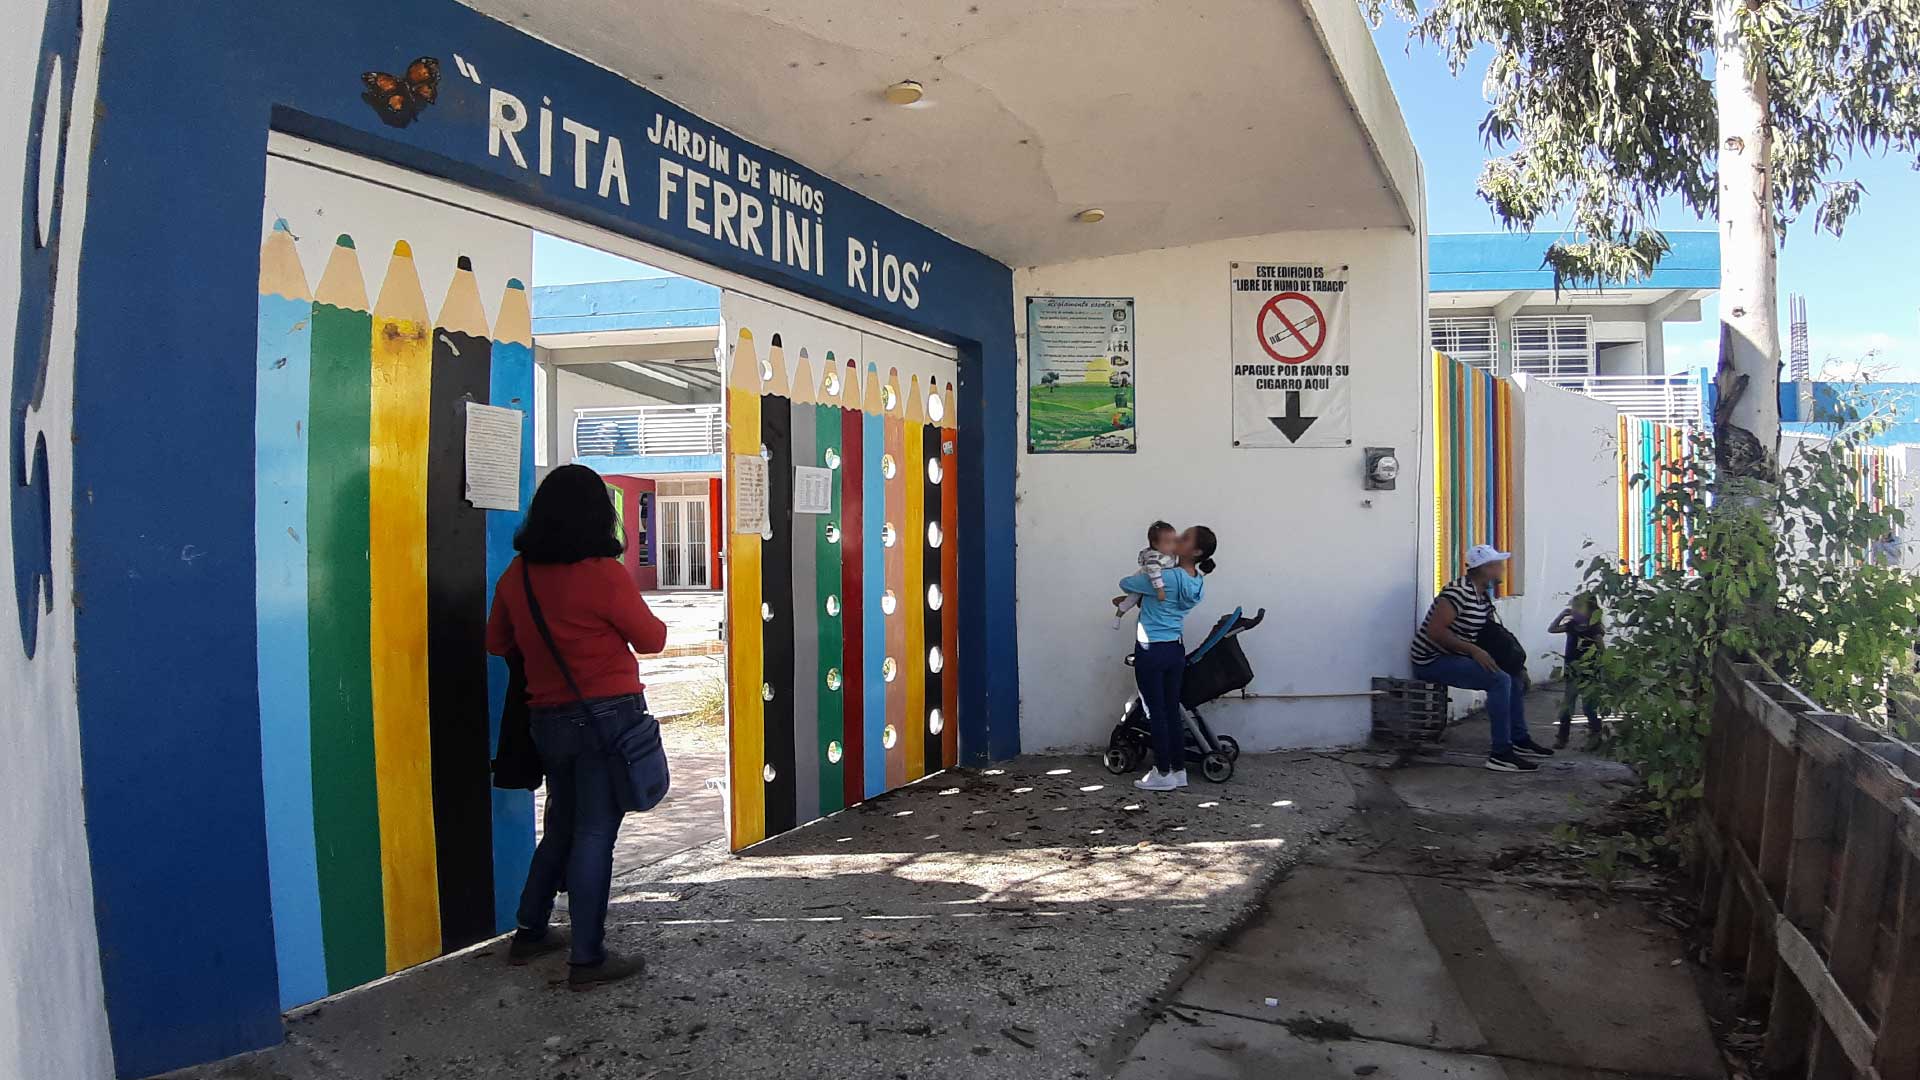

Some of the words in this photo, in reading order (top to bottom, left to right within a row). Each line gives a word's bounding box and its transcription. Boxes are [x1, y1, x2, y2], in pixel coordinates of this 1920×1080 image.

[737, 152, 761, 190] DE
[769, 167, 825, 217] NIÑOS
[1257, 266, 1276, 278] ESTE
[1277, 266, 1313, 278] EDIFICIO
[1314, 267, 1324, 278] ES
[1262, 280, 1272, 291] DE
[1273, 280, 1299, 292] HUMO
[1300, 280, 1311, 292] DE
[1235, 365, 1275, 377] APAGUE
[1278, 365, 1298, 376] POR
[1301, 365, 1333, 376] FAVOR
[1335, 365, 1349, 376] SU
[1256, 378, 1302, 390] CIGARRO
